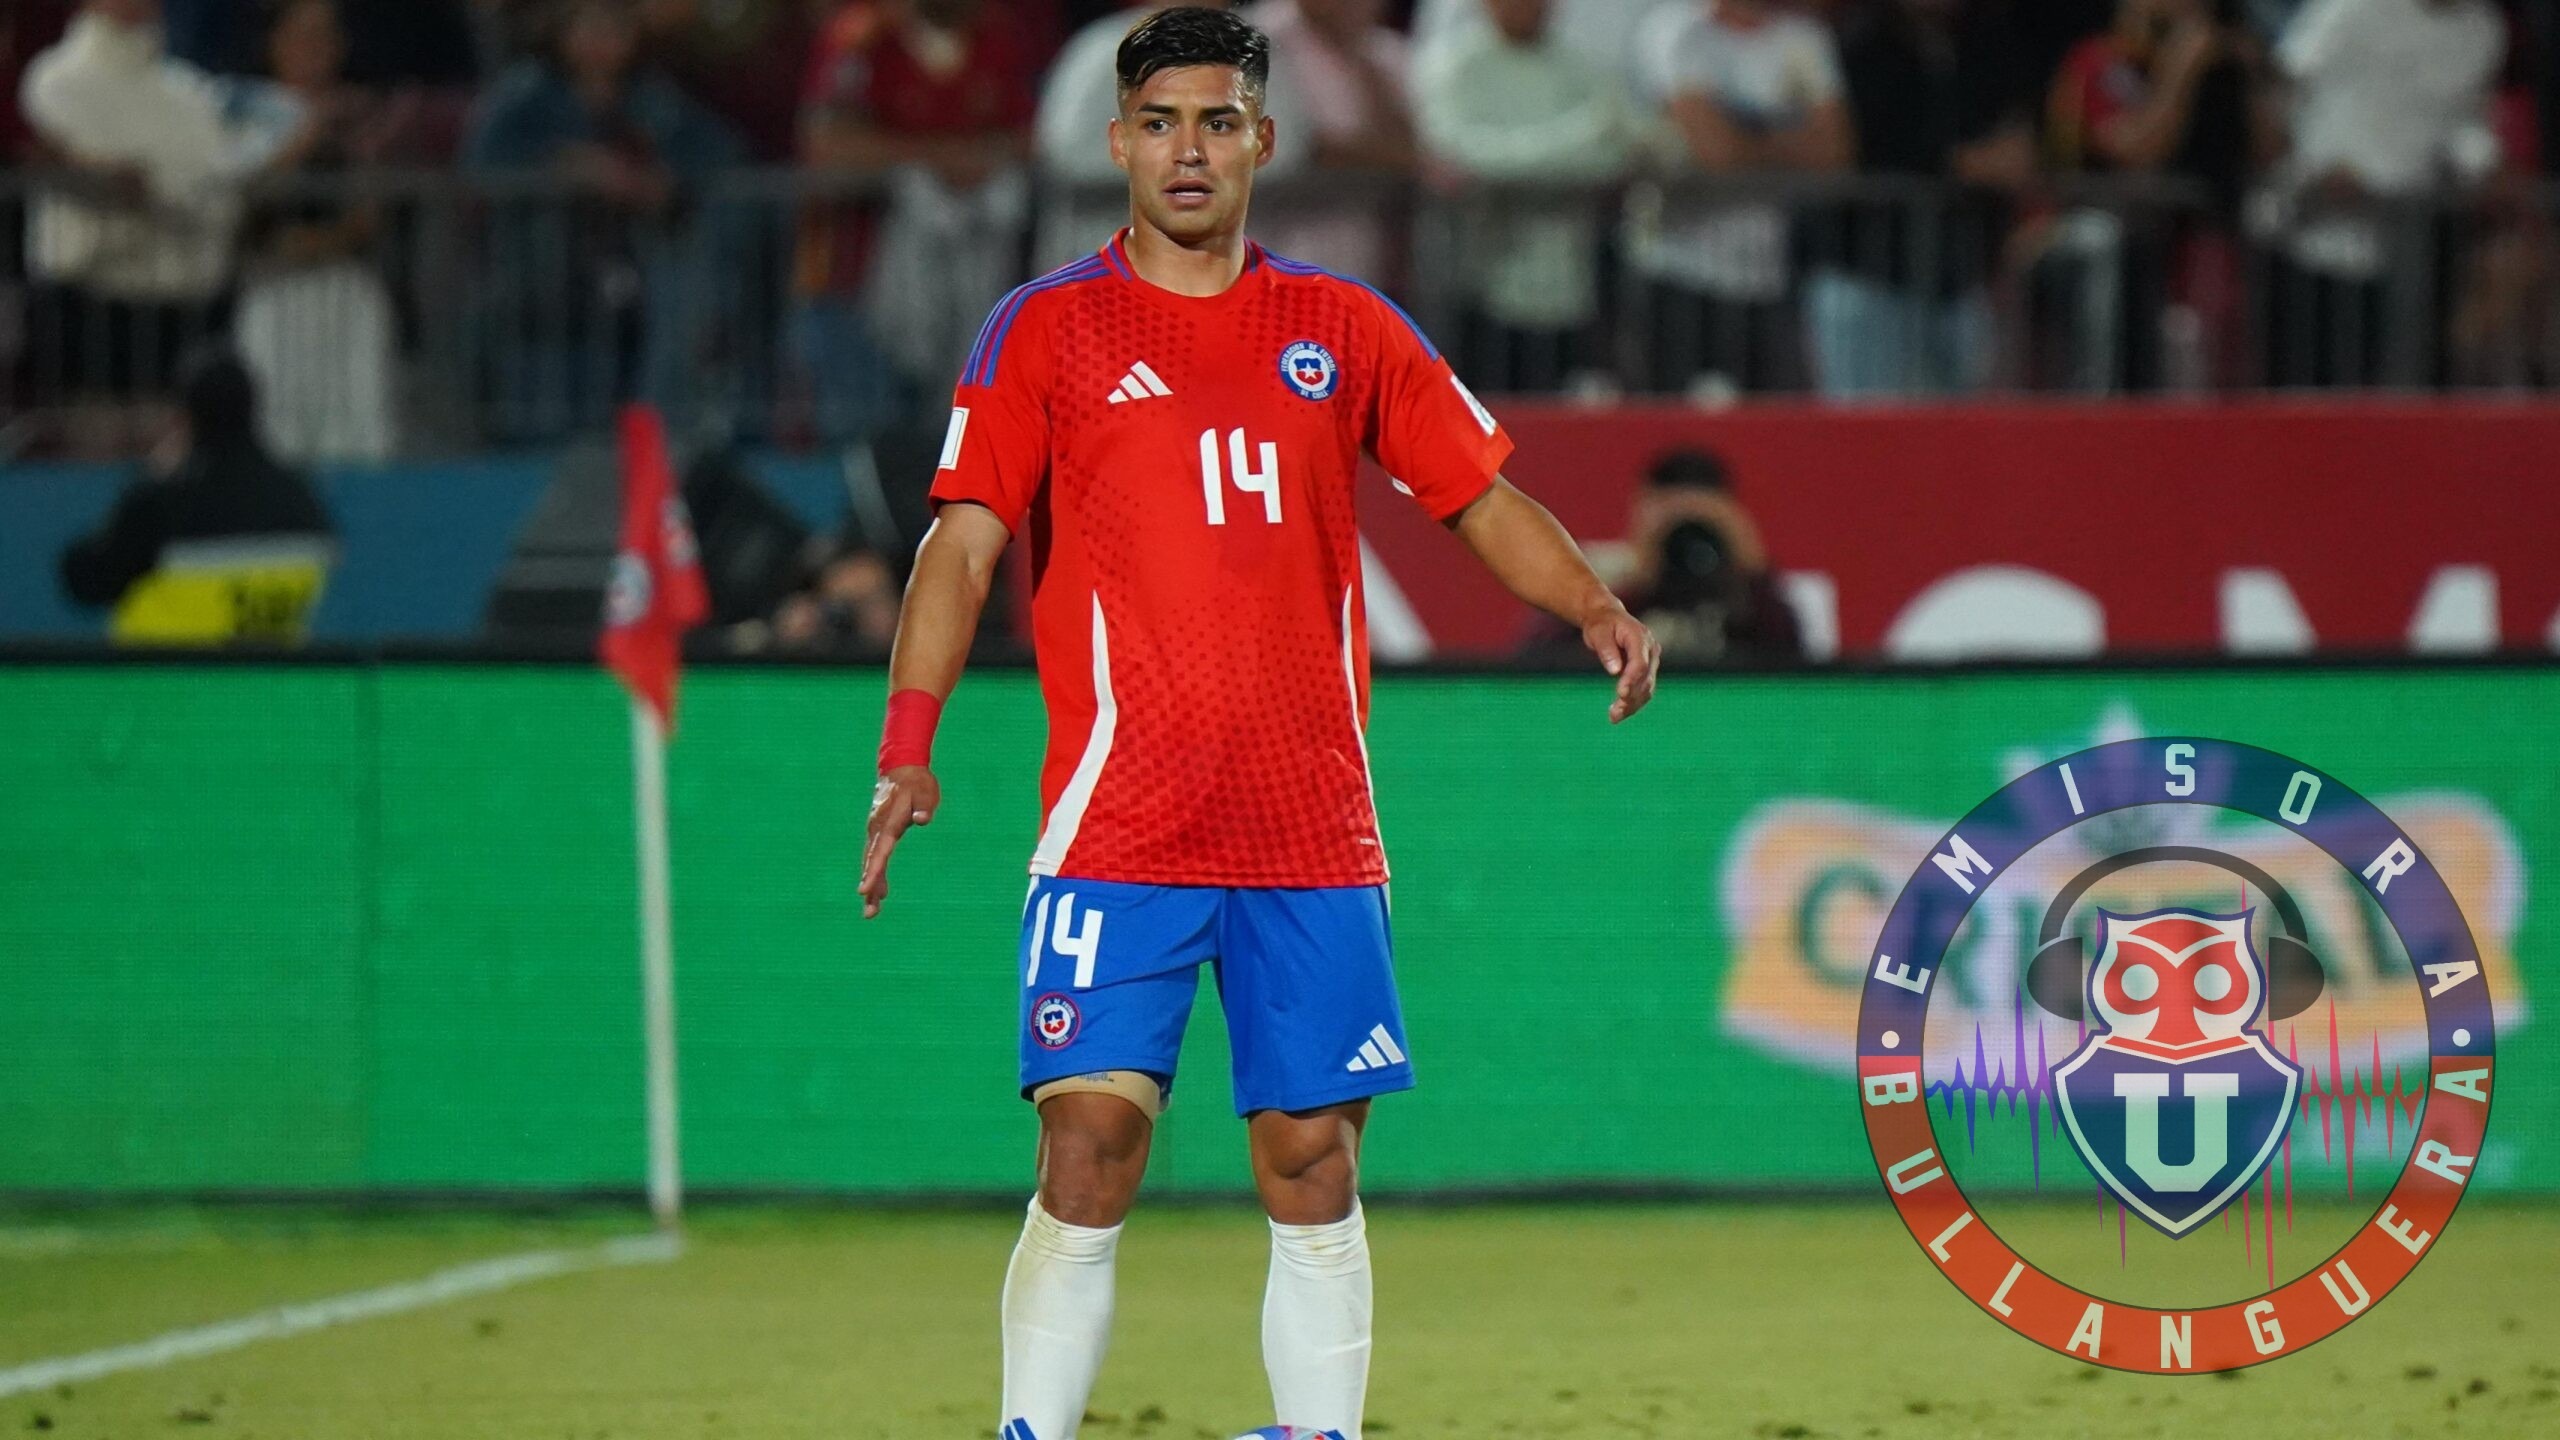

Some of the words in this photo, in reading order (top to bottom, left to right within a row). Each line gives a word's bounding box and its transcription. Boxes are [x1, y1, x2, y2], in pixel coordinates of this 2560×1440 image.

[1199, 427, 1283, 525] 14
[1026, 892, 1104, 988] 14
[1794, 856, 2458, 1016] CRITAL
